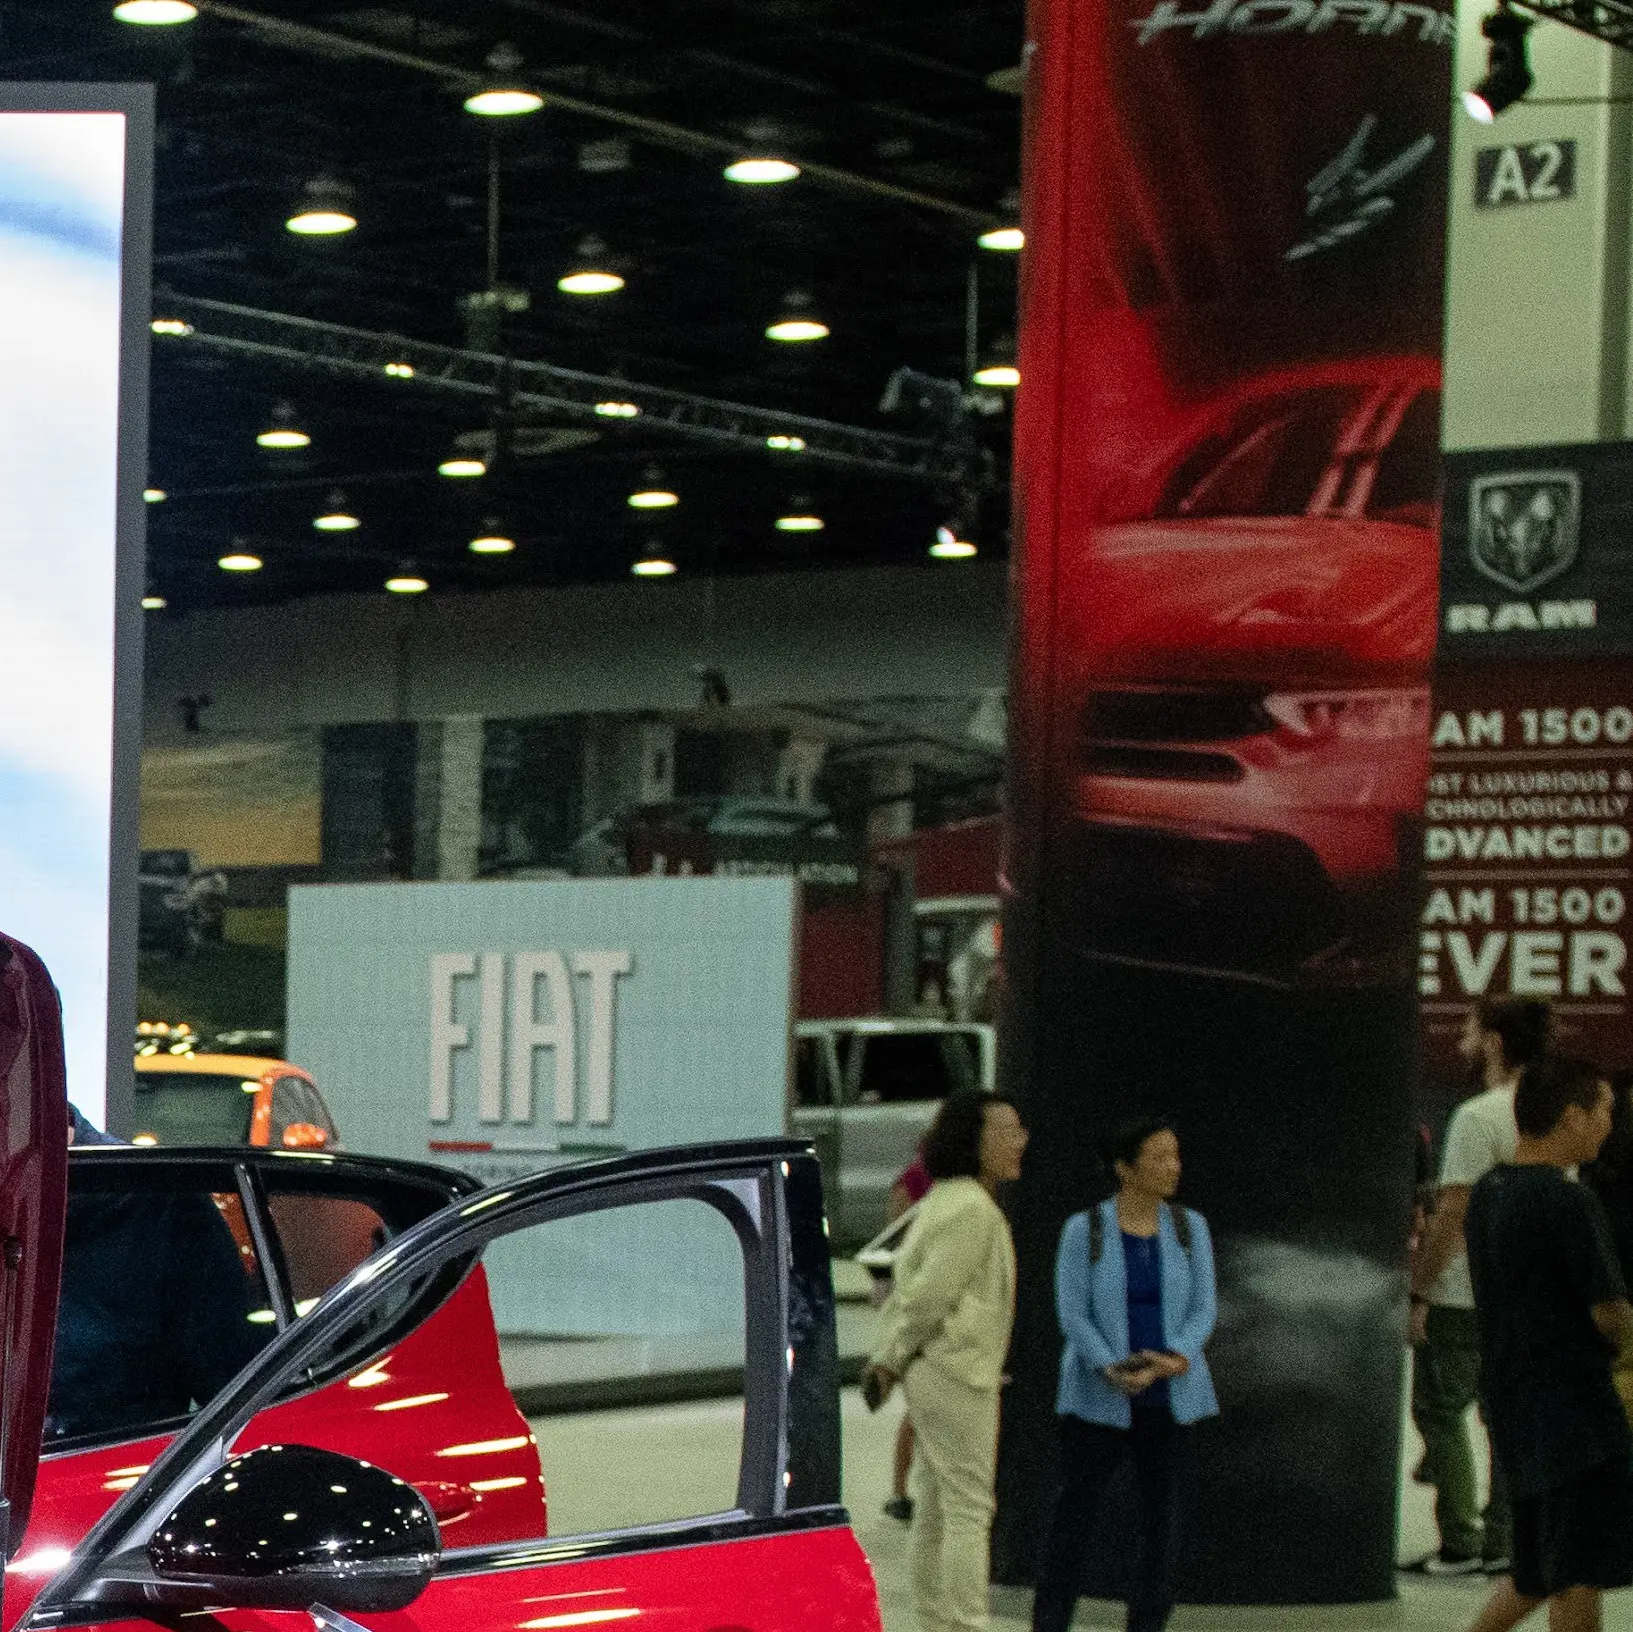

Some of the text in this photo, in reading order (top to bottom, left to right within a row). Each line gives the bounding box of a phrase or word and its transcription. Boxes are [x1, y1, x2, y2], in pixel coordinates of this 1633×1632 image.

[1488, 144, 1561, 201] A2
[1446, 600, 1596, 633] RAM
[1432, 706, 1633, 747] AM 1500
[1469, 769, 1610, 795] LUXURIOUS
[1423, 823, 1631, 862] DVANCED
[1422, 886, 1626, 925] AM 1500
[428, 950, 634, 1126] FIAT
